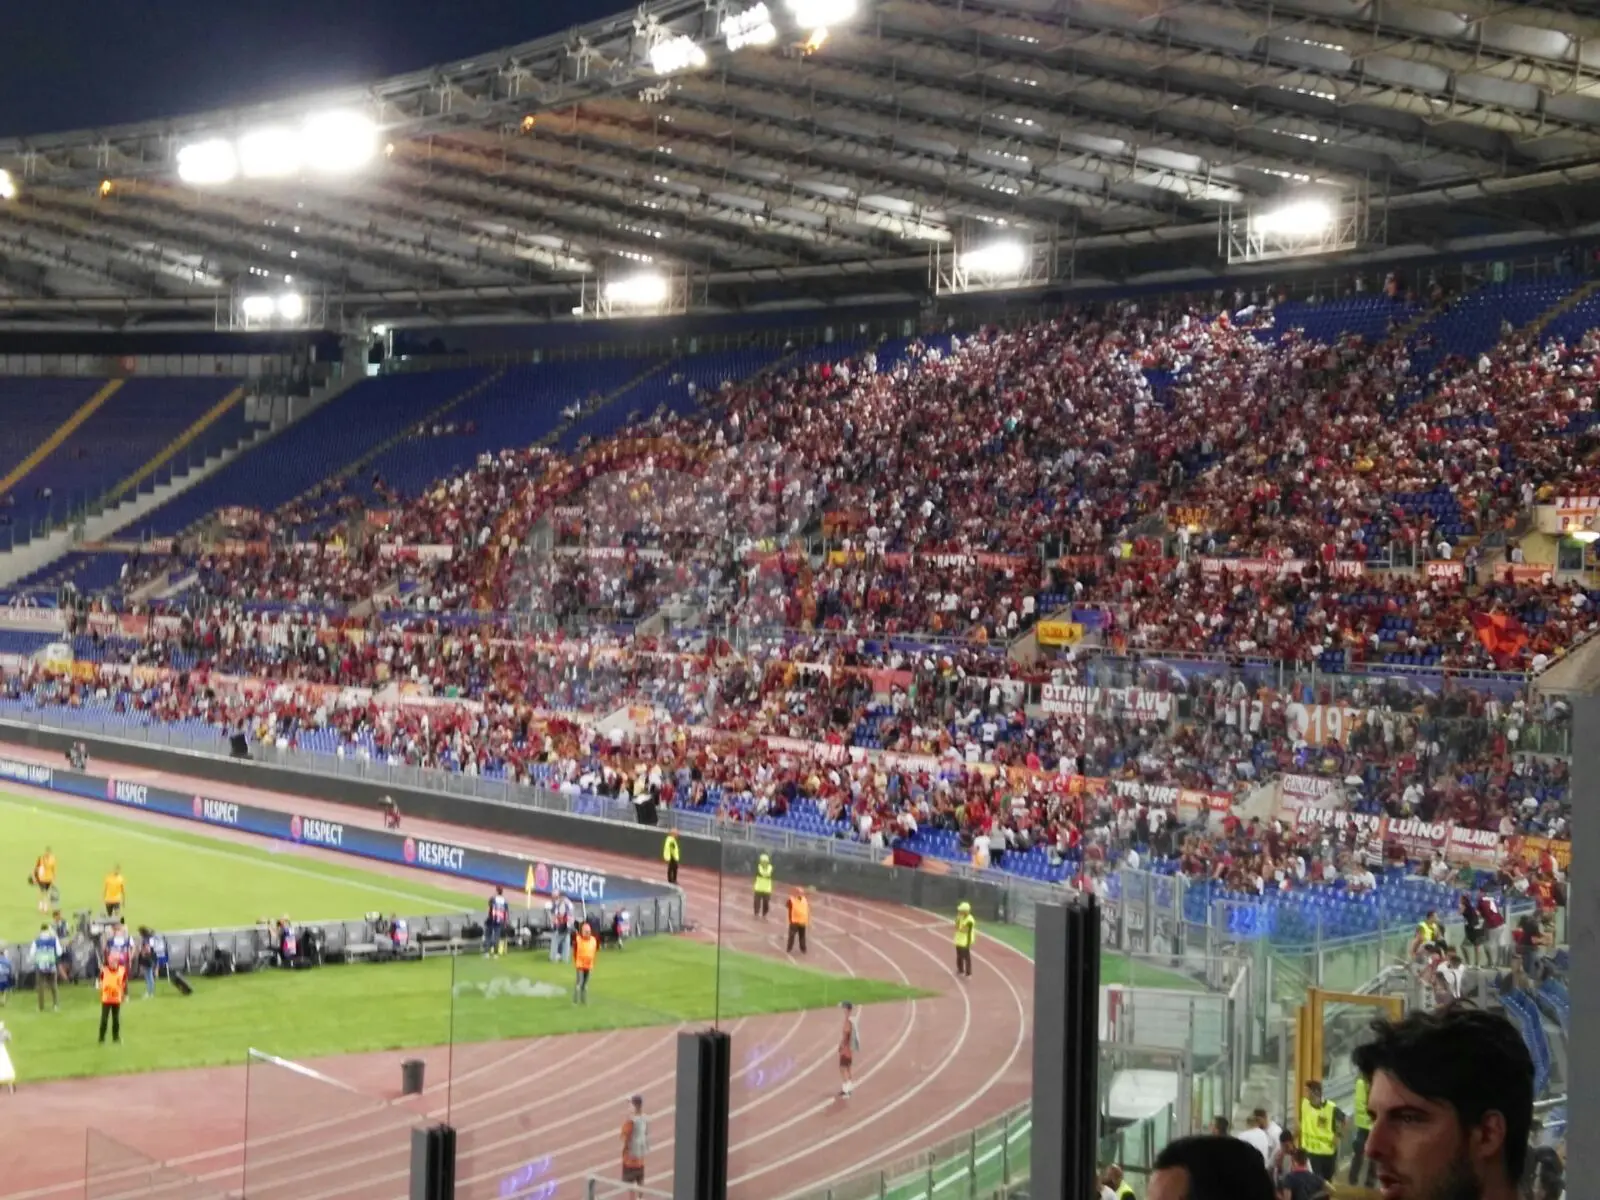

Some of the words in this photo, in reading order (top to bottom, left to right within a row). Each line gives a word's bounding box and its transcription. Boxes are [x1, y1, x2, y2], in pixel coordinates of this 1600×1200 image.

[116, 780, 148, 804] RESPECT
[204, 798, 239, 823] RESPECT
[1335, 811, 1380, 833] WRD
[303, 818, 344, 846] RESPECT
[1388, 820, 1445, 840] LUINO
[1452, 826, 1498, 847] MILANO
[418, 841, 465, 870] RESPECT
[551, 867, 606, 899] RESPECT
